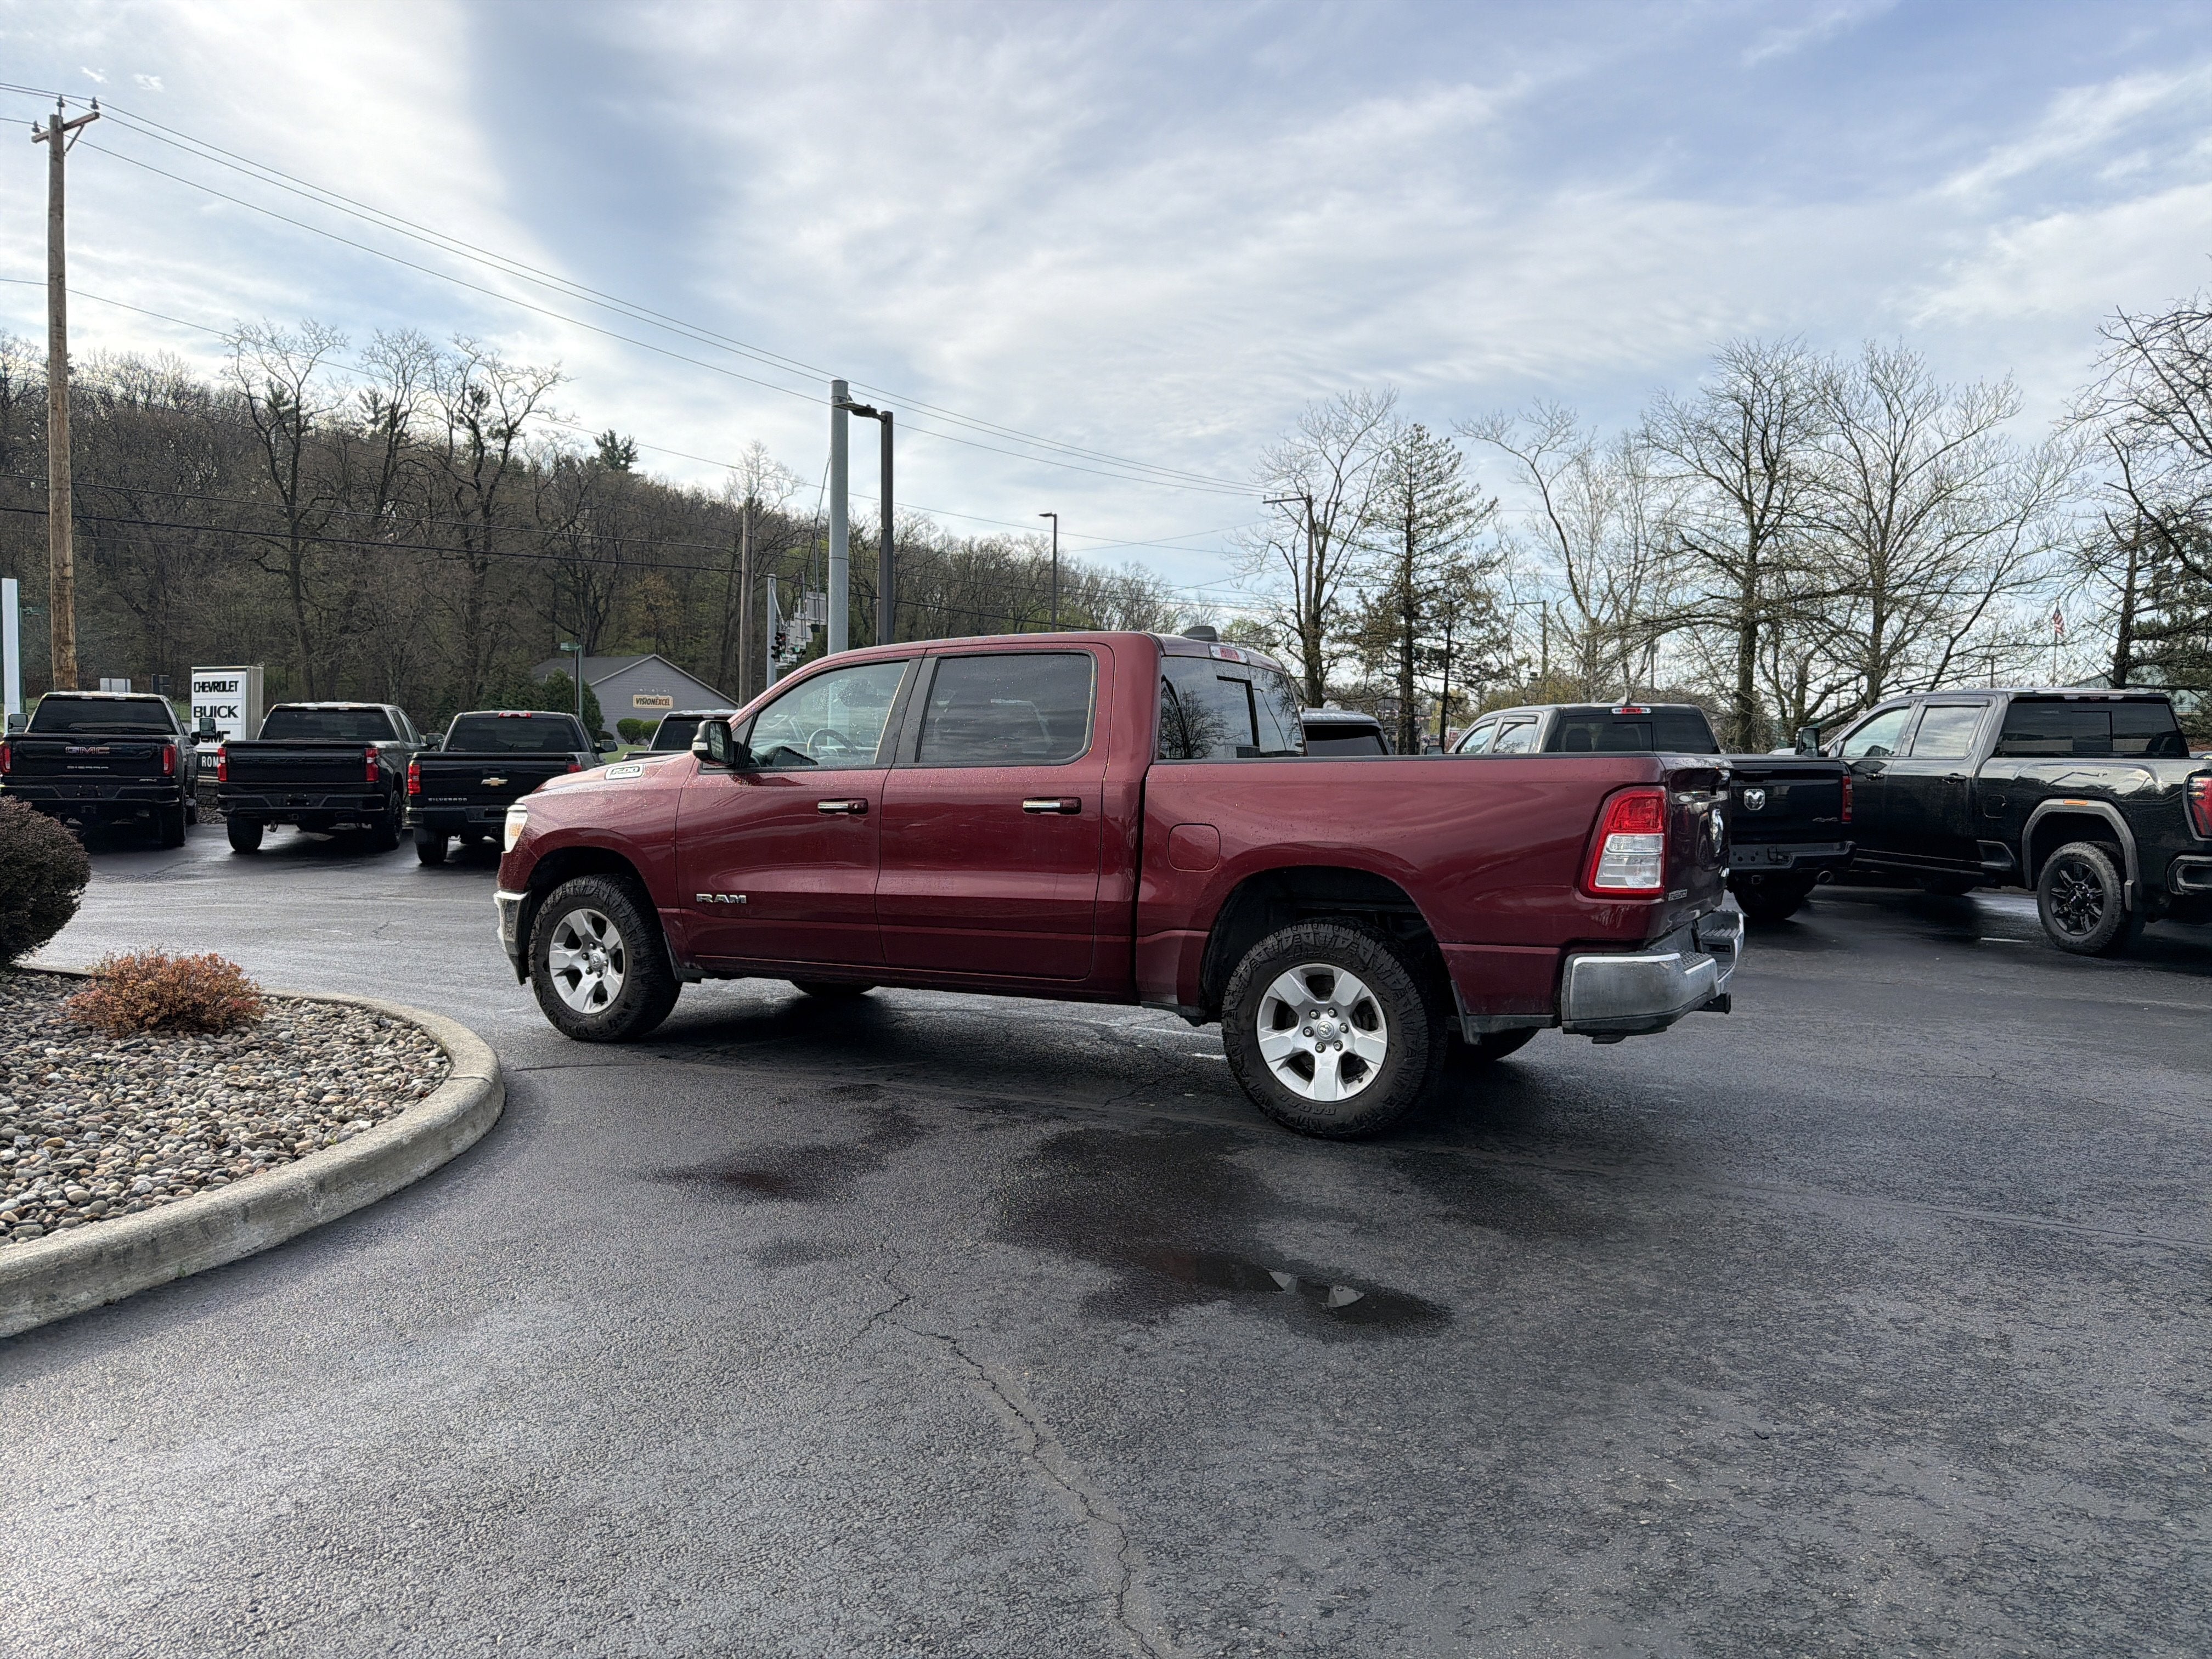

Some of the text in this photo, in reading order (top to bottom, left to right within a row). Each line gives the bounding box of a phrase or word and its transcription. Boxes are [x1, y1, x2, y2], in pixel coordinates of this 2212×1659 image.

[193, 680, 239, 693] CHEVROLET
[193, 705, 239, 719] BUICK
[65, 746, 110, 754] GMC
[696, 894, 747, 904] RAM
